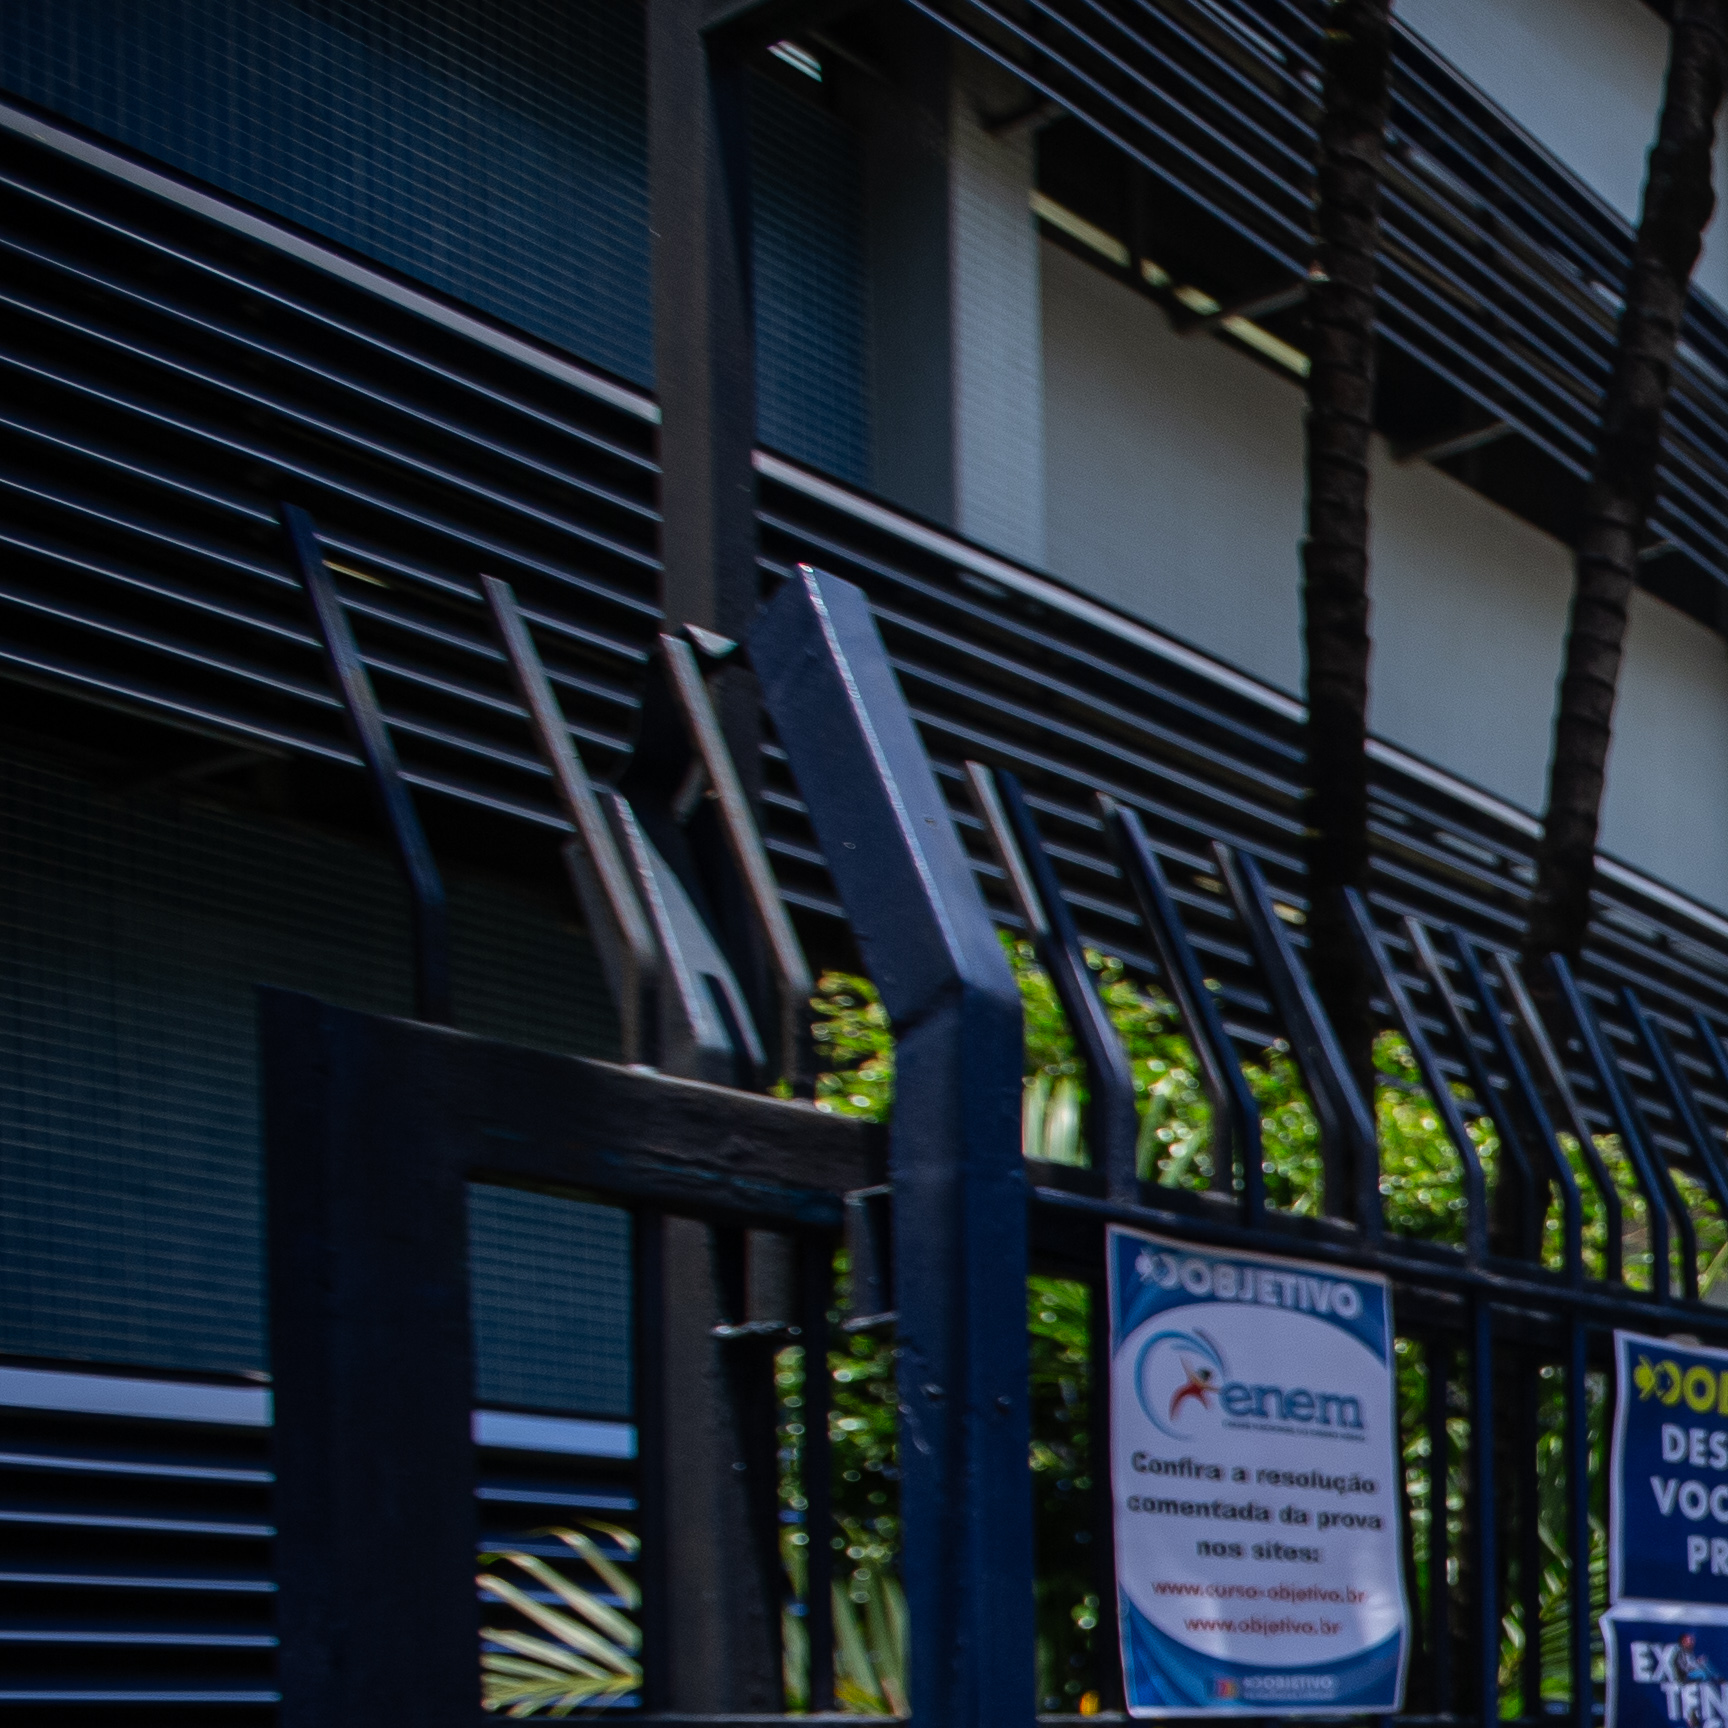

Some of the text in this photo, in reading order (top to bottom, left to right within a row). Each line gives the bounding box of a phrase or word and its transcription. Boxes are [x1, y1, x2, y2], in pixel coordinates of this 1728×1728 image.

[1181, 1260, 1361, 1320] OBJETIVO
[1220, 1381, 1364, 1430] enem
[1131, 1451, 1376, 1495] Confira a resolução
[1126, 1493, 1383, 1533] comentada da prova
[1197, 1539, 1321, 1564] nos sites:
[1151, 1578, 1366, 1606] www.curso-objetivo.br
[1184, 1615, 1341, 1637] www.objetivo.br
